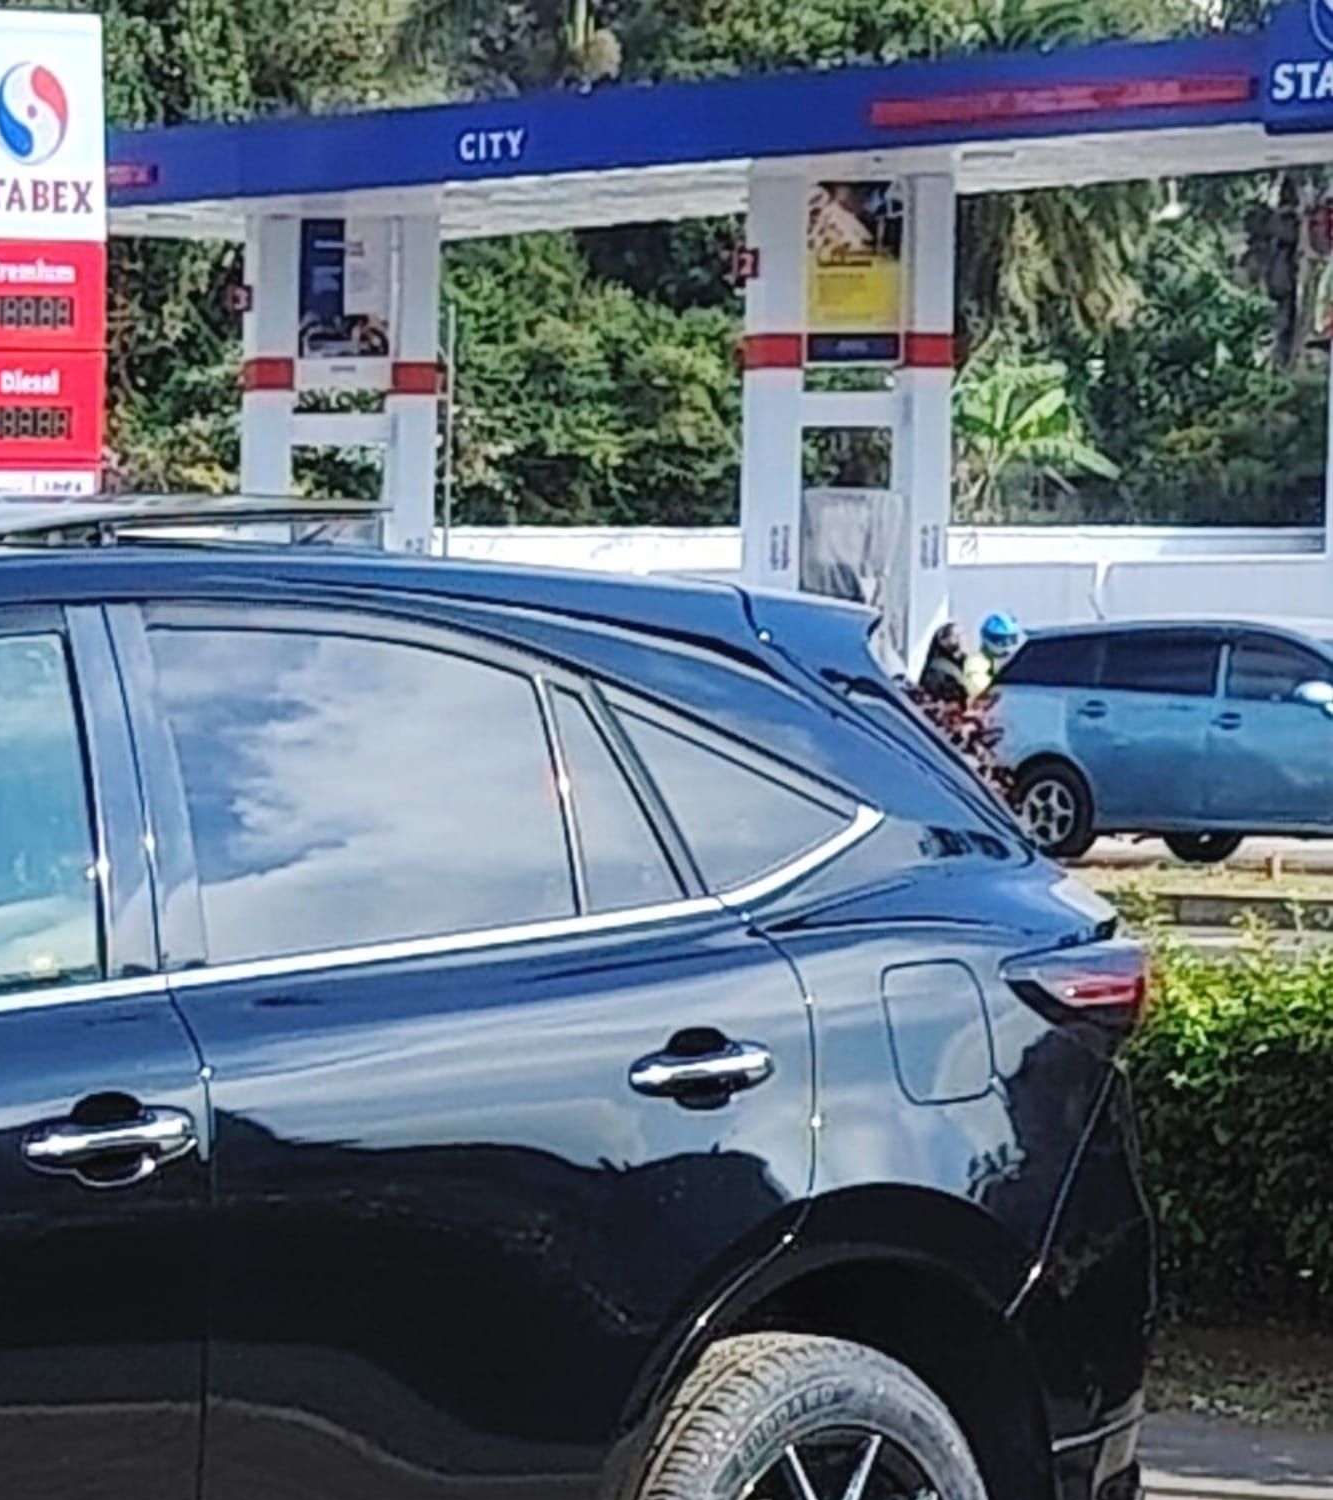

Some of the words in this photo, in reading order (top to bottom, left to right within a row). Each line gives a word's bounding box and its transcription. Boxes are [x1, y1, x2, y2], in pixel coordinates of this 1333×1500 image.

[1272, 61, 1333, 100] STA
[460, 127, 524, 161] CITY
[0, 369, 60, 394] Diesel
